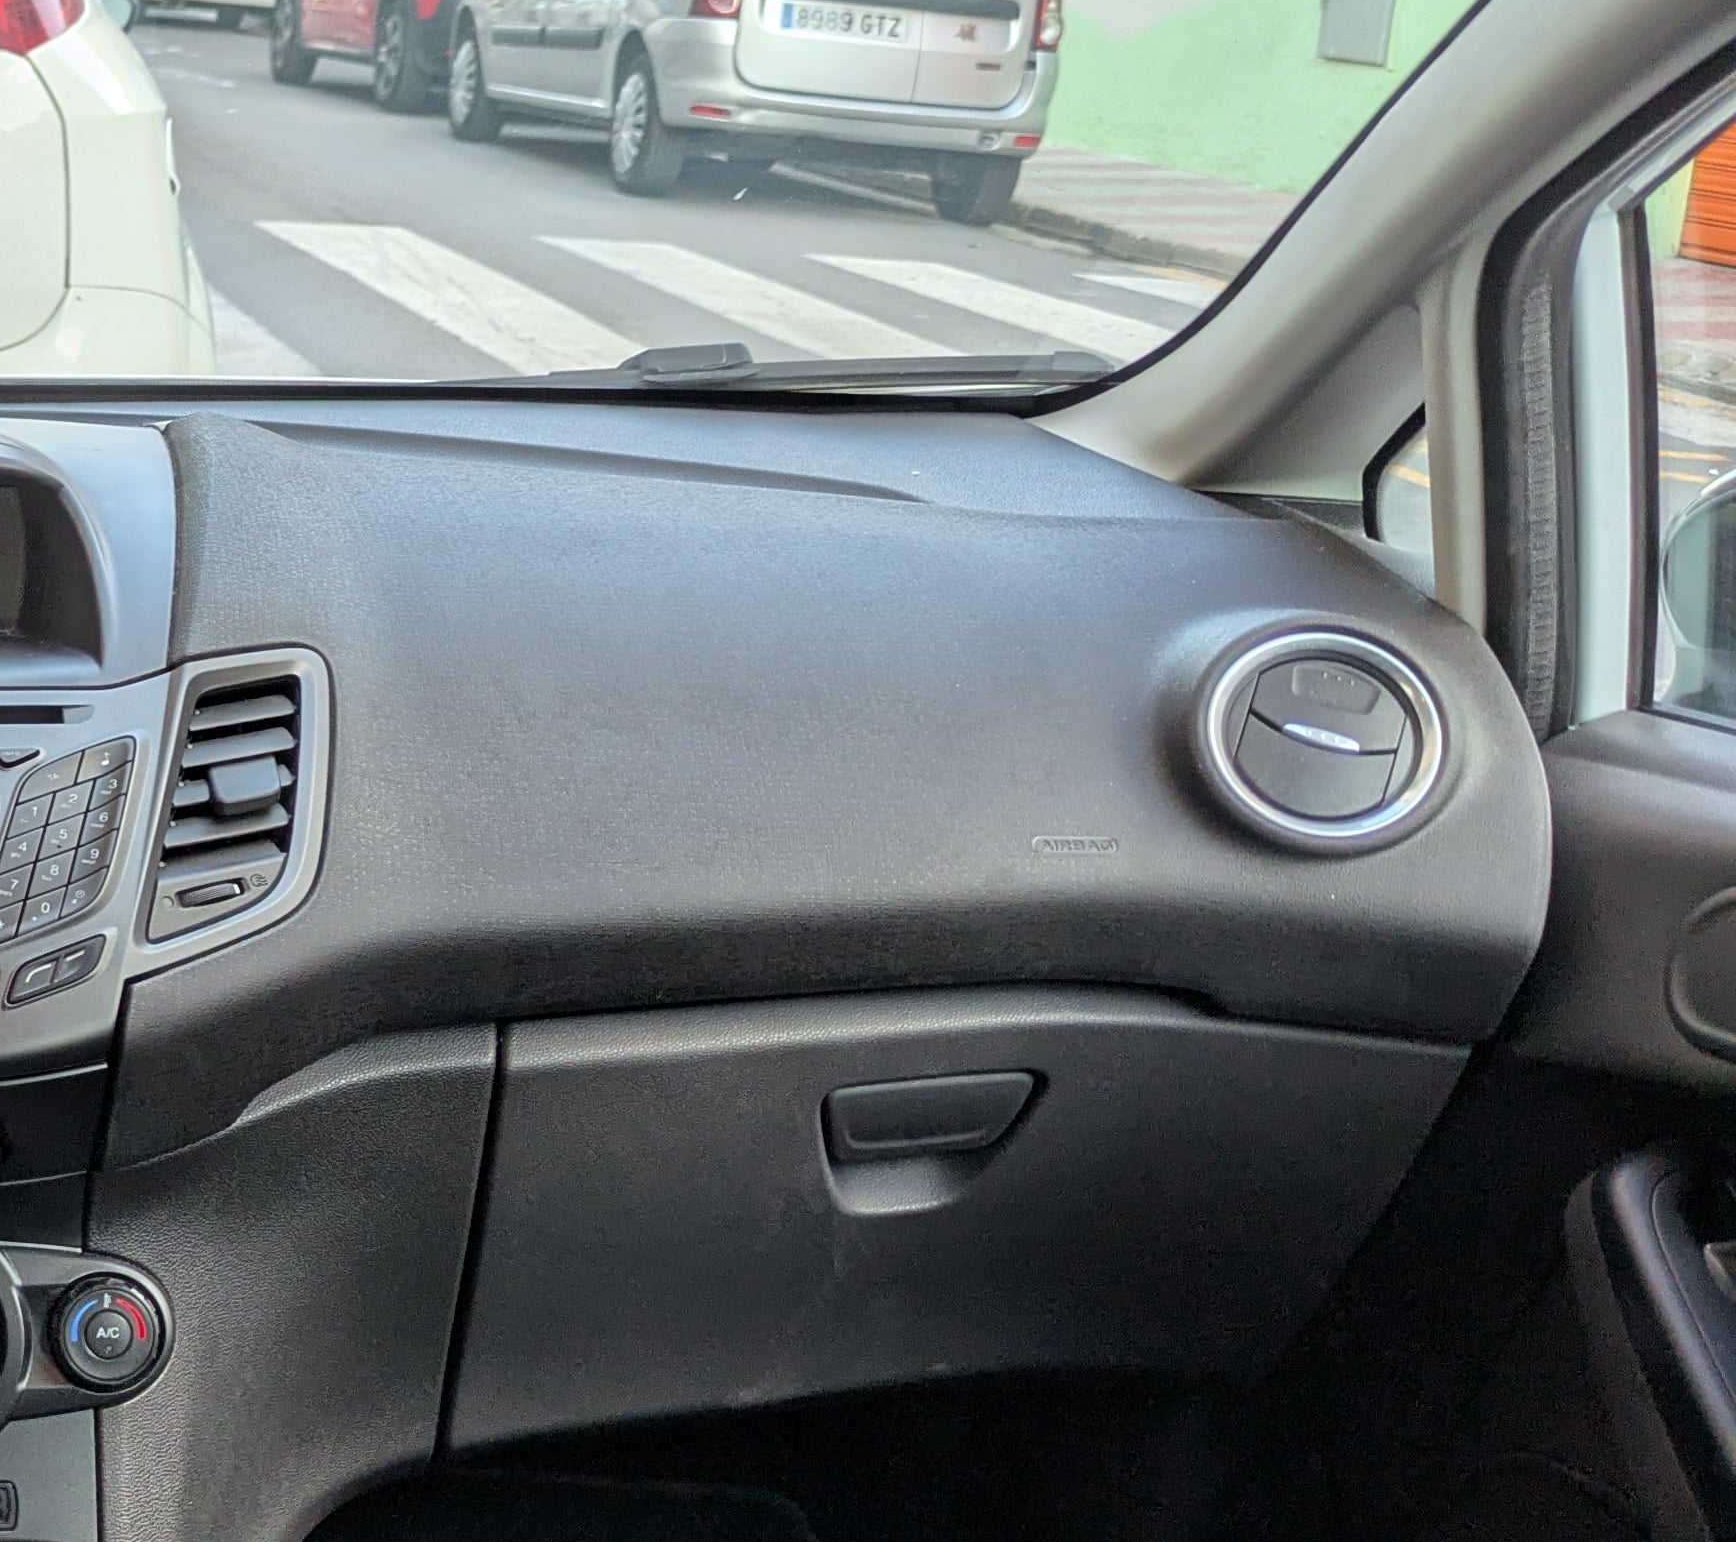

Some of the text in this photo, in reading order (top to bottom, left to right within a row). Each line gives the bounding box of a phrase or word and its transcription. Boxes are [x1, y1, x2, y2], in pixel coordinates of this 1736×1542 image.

[796, 8, 901, 38] 8989 GTZ
[108, 778, 118, 789] 3
[68, 793, 78, 803] 2
[32, 806, 38, 816] 1
[99, 811, 109, 822] 6
[59, 829, 68, 839] 5
[18, 841, 28, 852] 4
[90, 848, 100, 859] 9
[50, 864, 59, 876] 8
[10, 879, 19, 890] 7
[41, 902, 50, 913] 0
[96, 1326, 121, 1339] A/C
